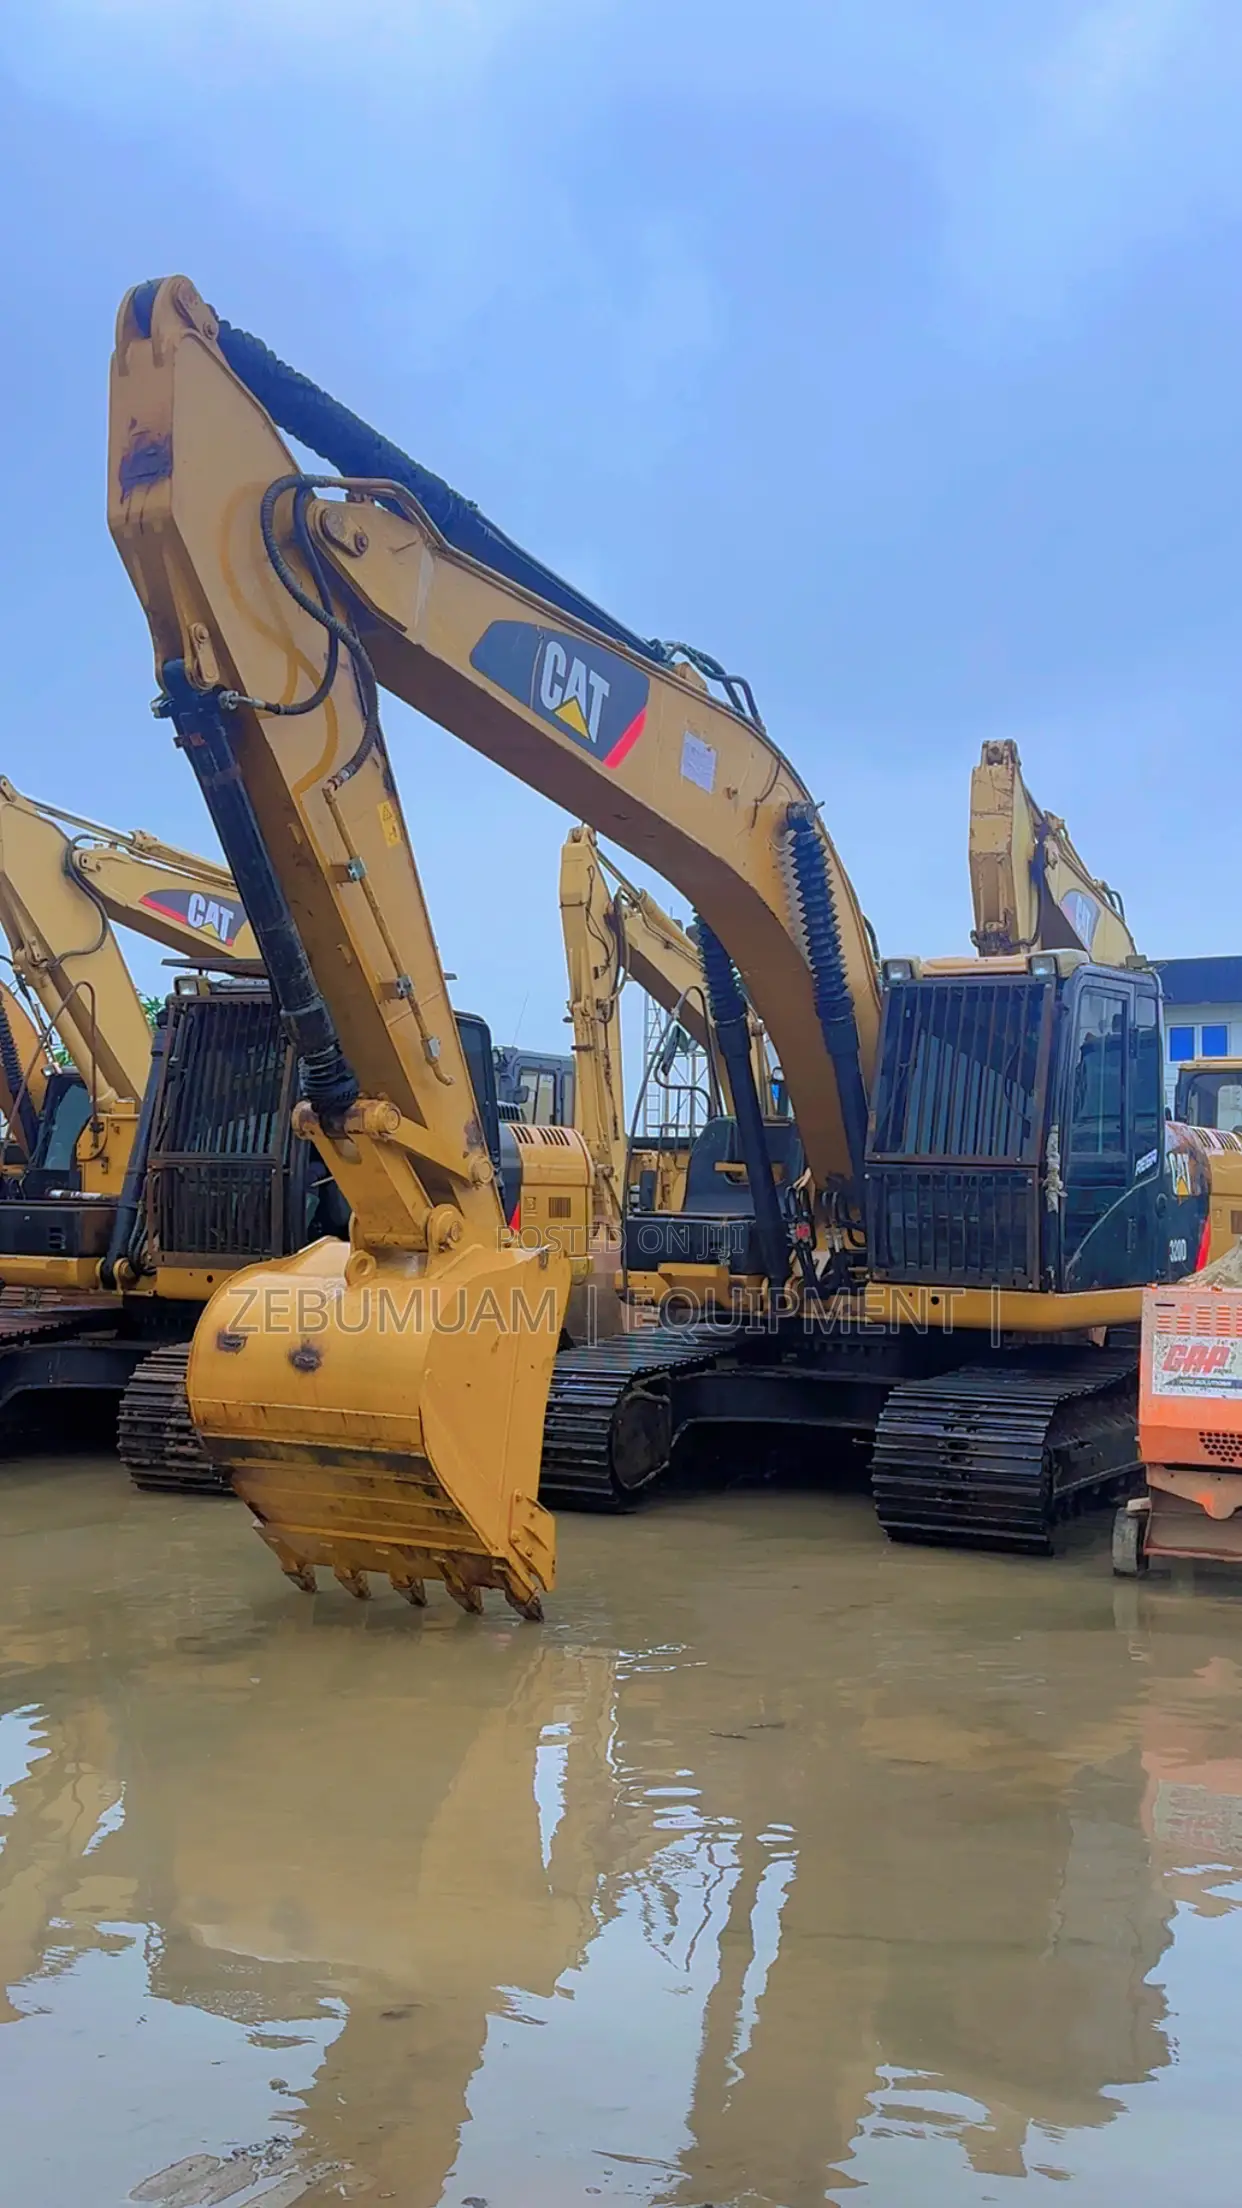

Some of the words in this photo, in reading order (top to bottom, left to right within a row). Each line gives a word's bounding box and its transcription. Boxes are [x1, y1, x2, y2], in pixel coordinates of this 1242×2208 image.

[540, 641, 610, 743] CAT
[187, 893, 234, 942] CAT
[1169, 1238, 1187, 1262] 320D
